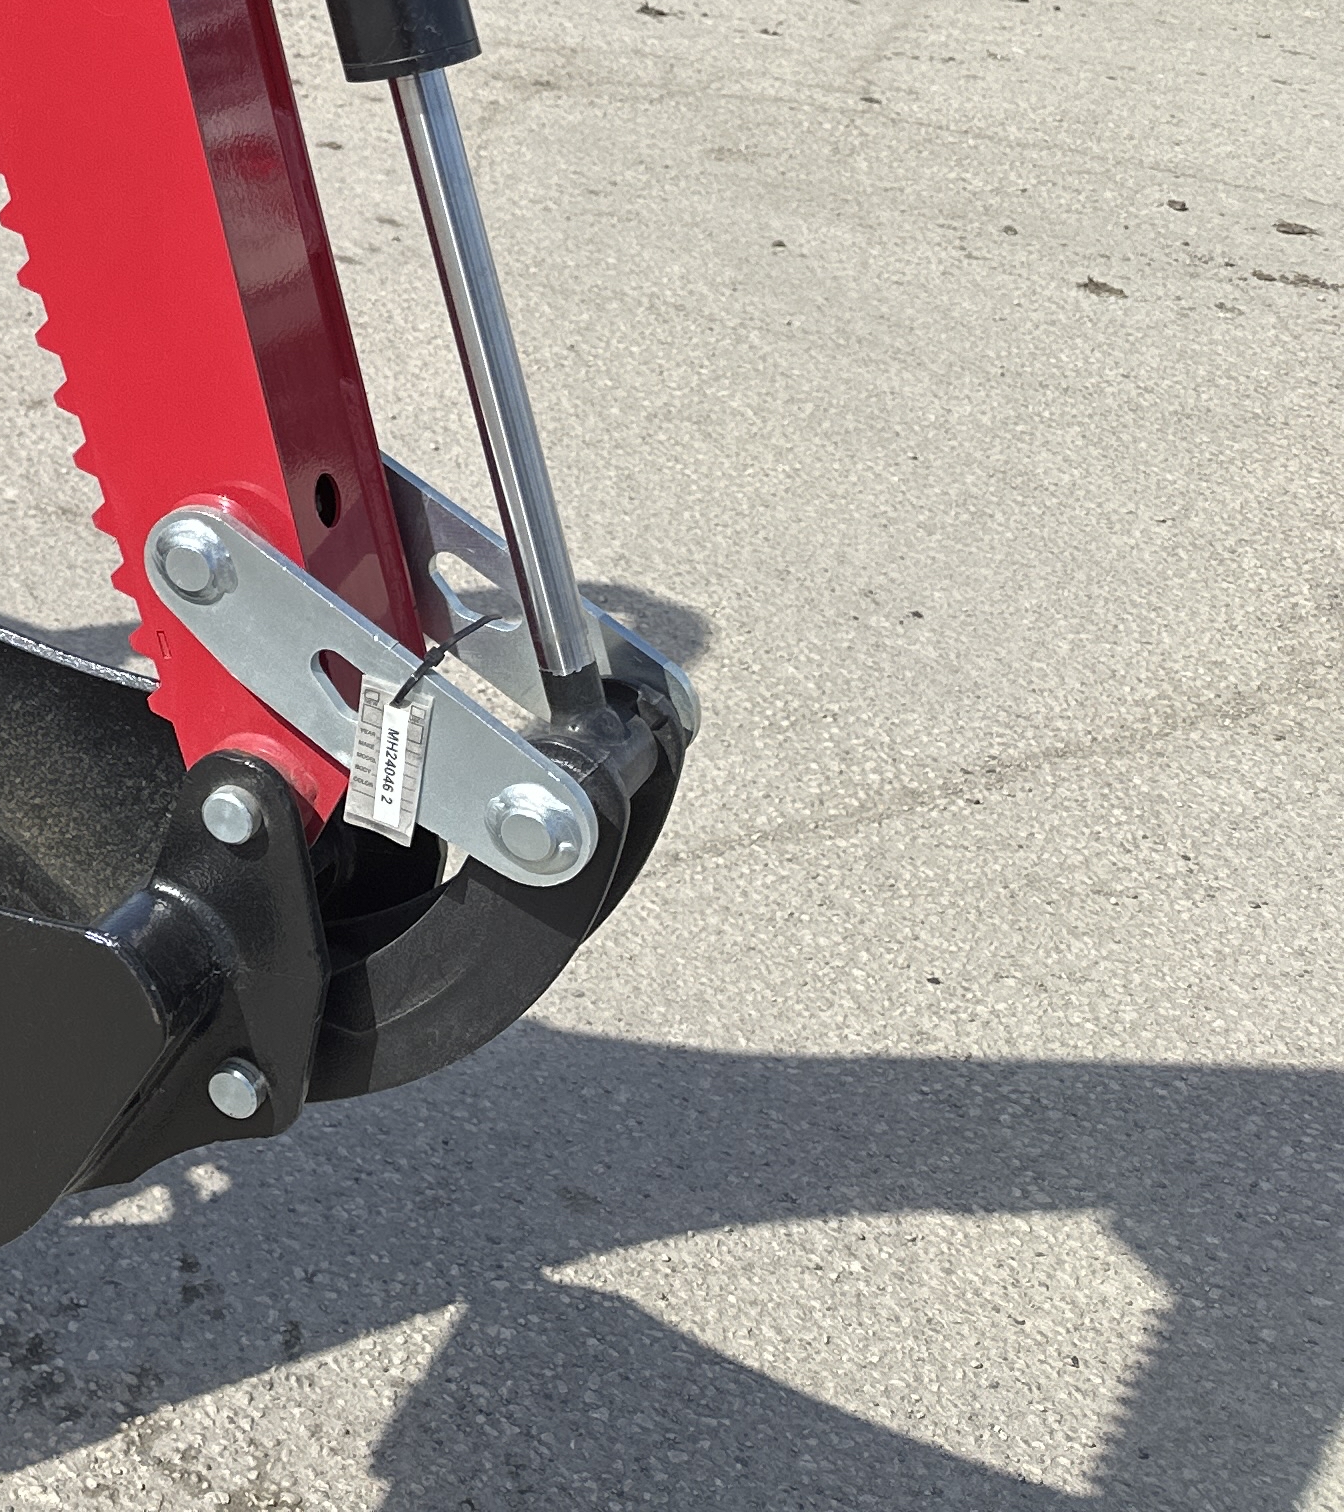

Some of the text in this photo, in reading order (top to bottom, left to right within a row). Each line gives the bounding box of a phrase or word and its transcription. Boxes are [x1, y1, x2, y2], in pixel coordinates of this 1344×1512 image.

[352, 775, 374, 787] COLOR
[380, 727, 400, 805] MH24046 2
